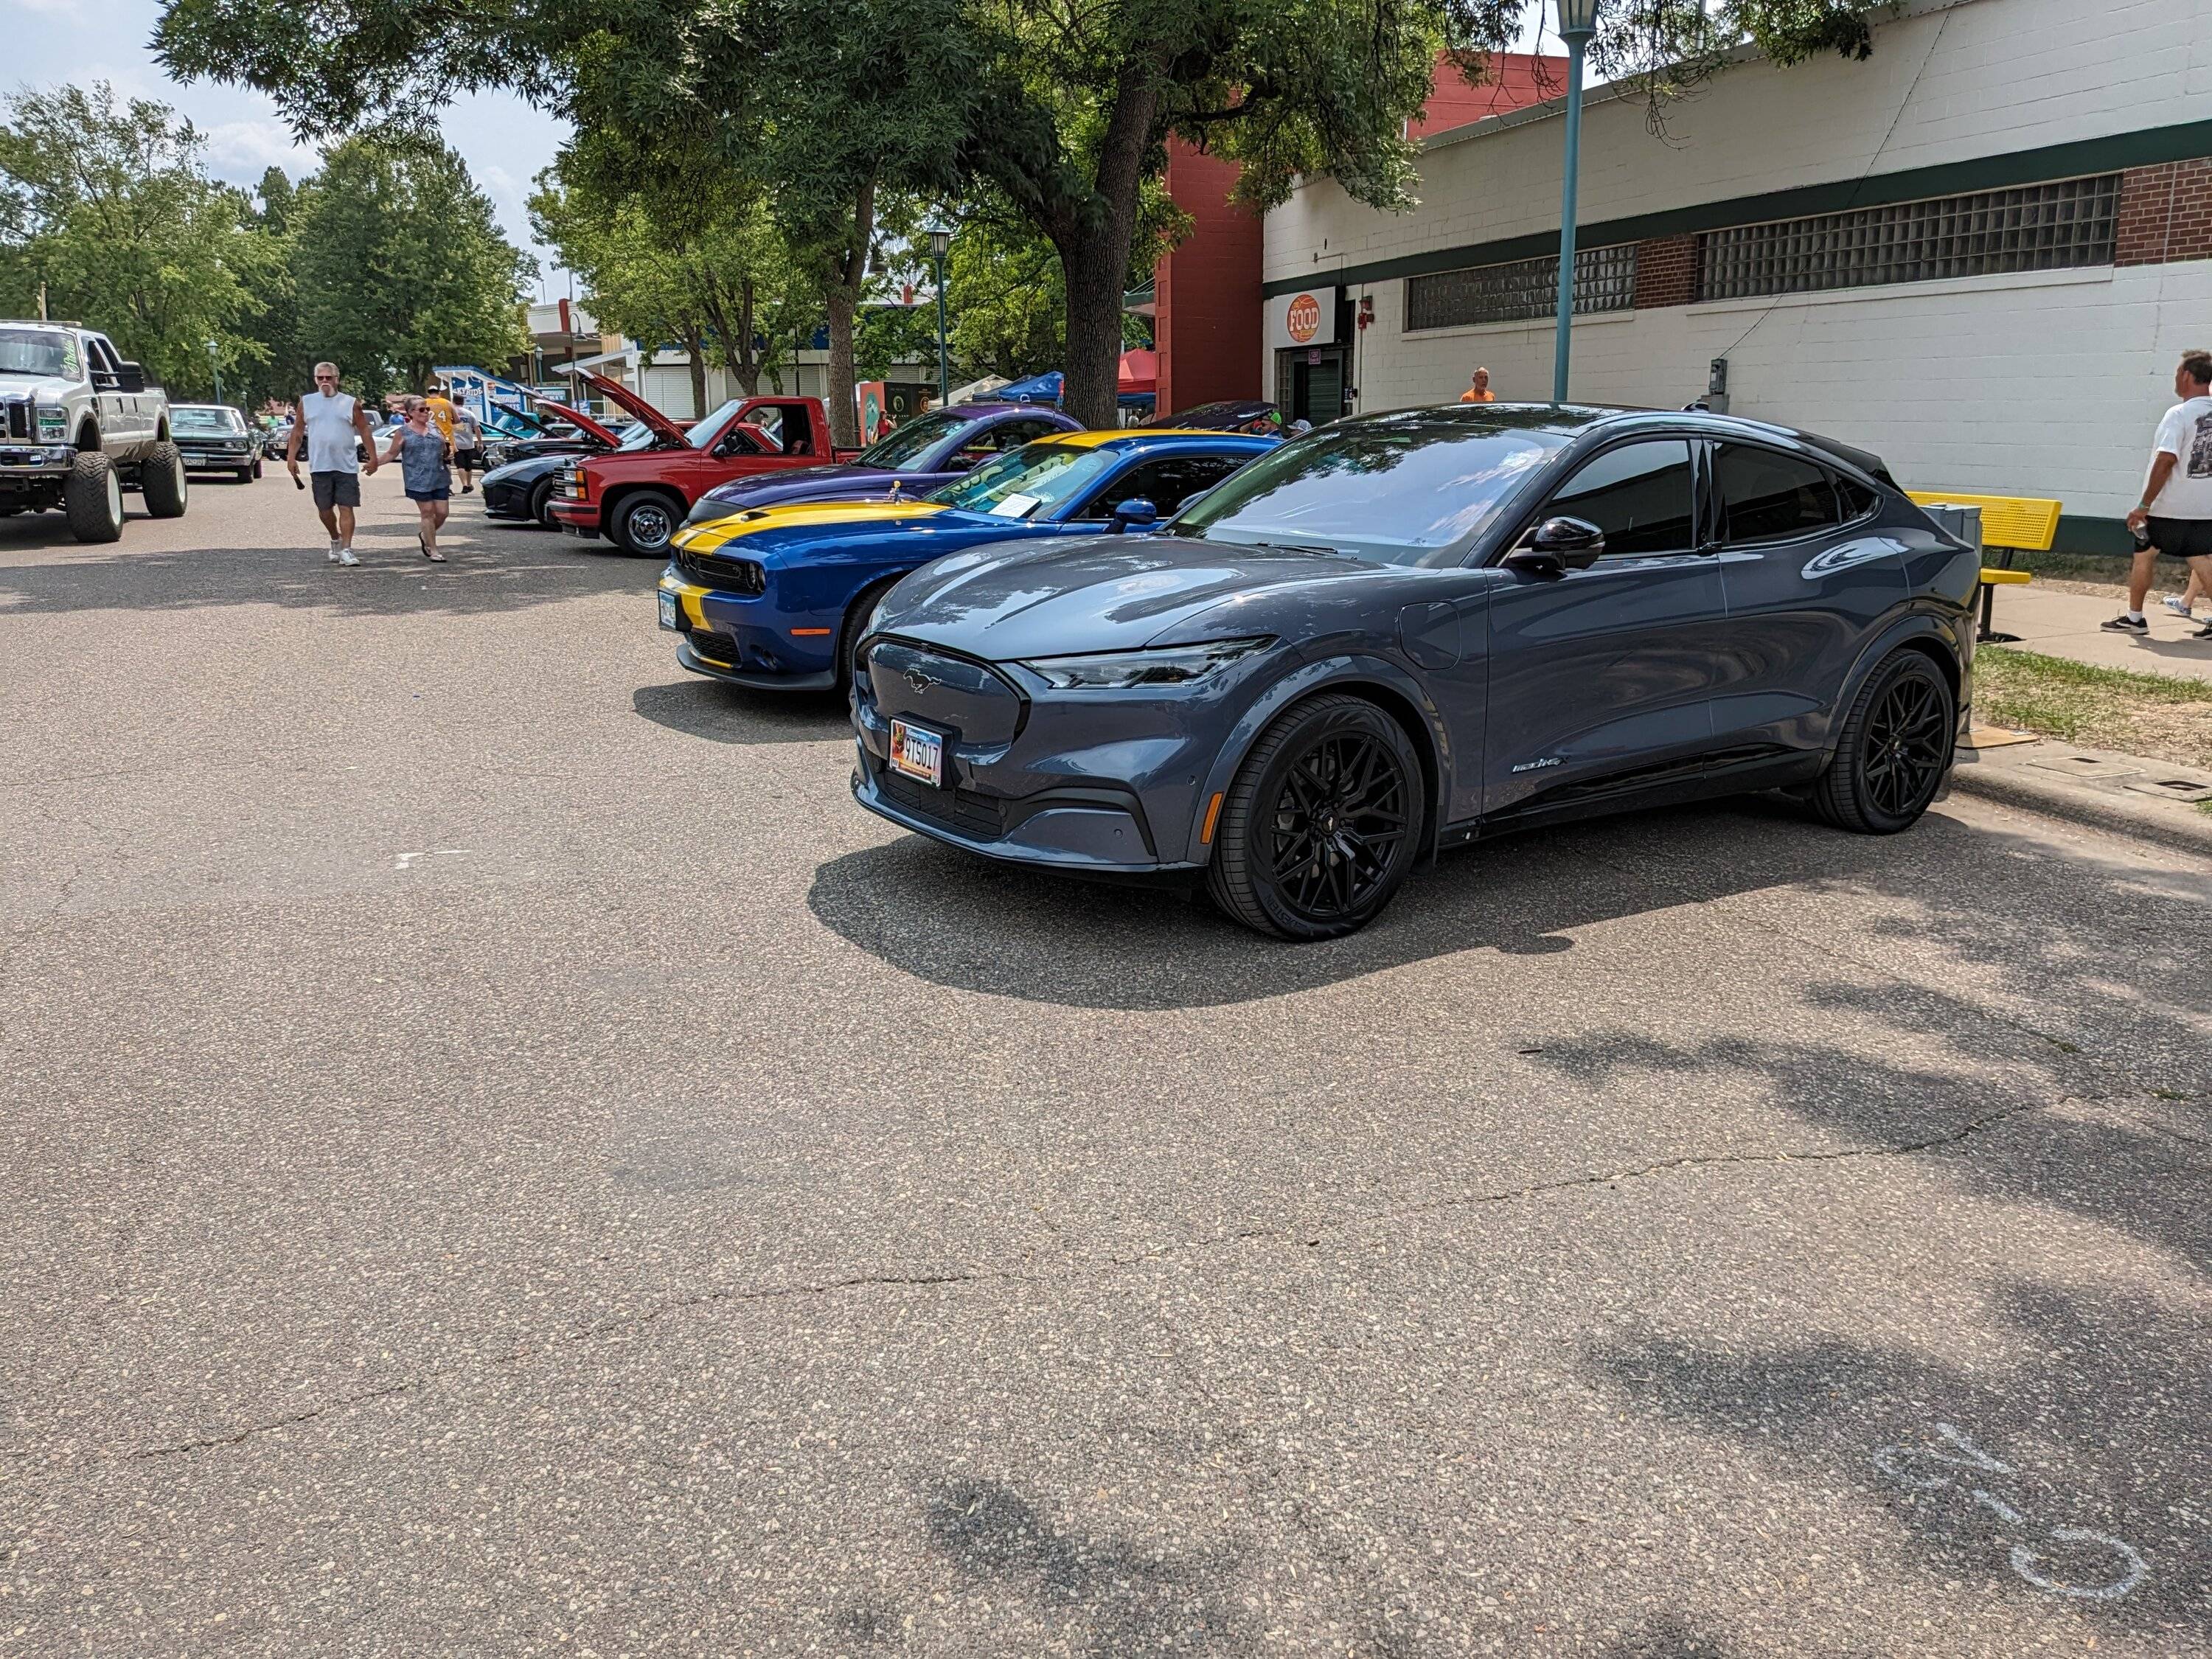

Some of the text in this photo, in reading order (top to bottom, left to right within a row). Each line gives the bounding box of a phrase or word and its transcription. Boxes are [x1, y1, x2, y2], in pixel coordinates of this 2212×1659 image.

[1290, 307, 1320, 331] FOOD
[428, 410, 447, 422] 24
[905, 737, 938, 771] 9TS017
